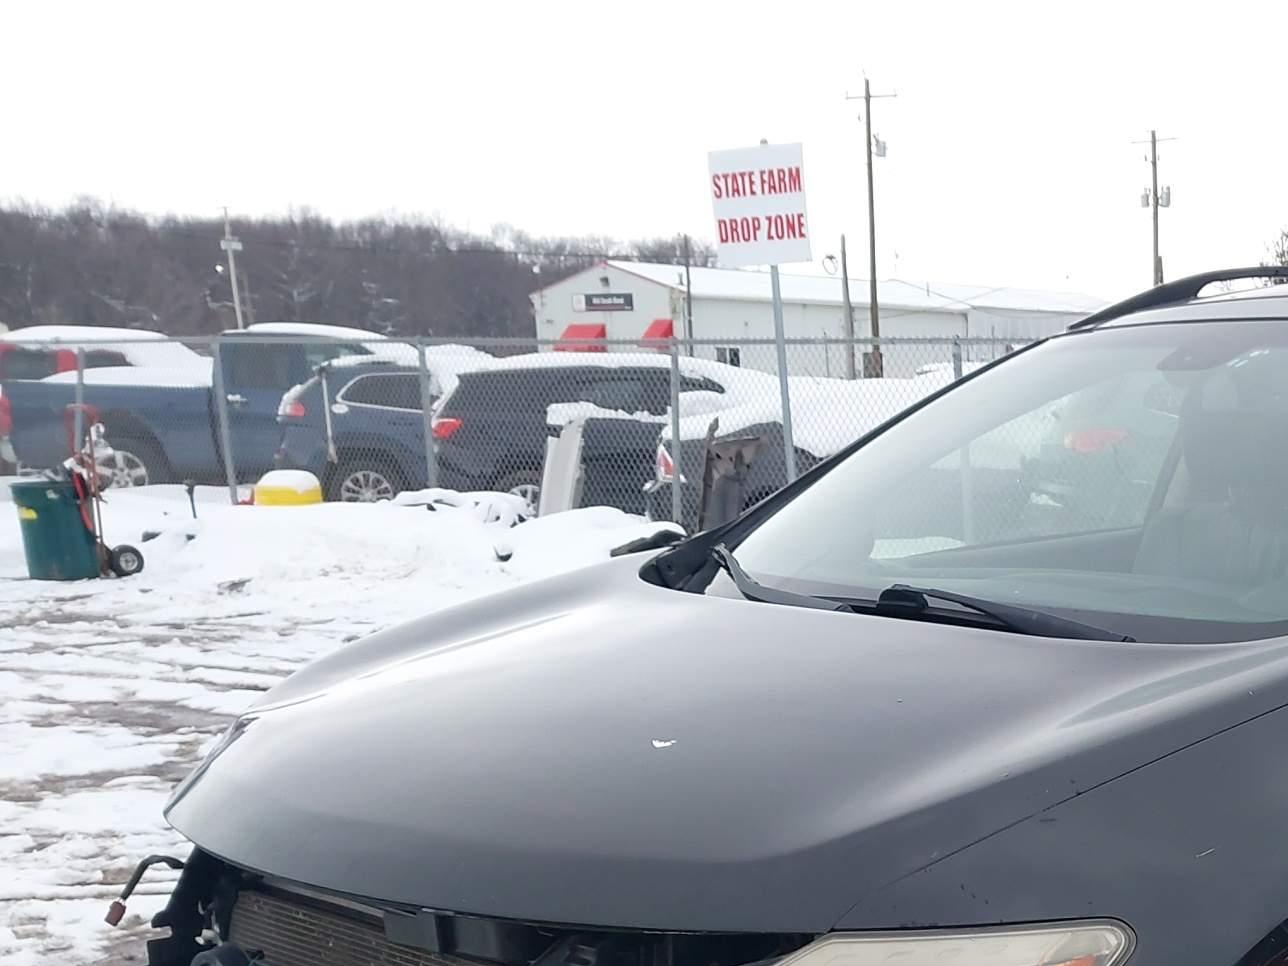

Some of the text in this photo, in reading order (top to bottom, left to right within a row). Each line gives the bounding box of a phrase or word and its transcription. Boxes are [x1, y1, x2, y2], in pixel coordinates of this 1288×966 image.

[712, 167, 802, 199] STATE FARM
[717, 213, 807, 244] DROP ZONE
